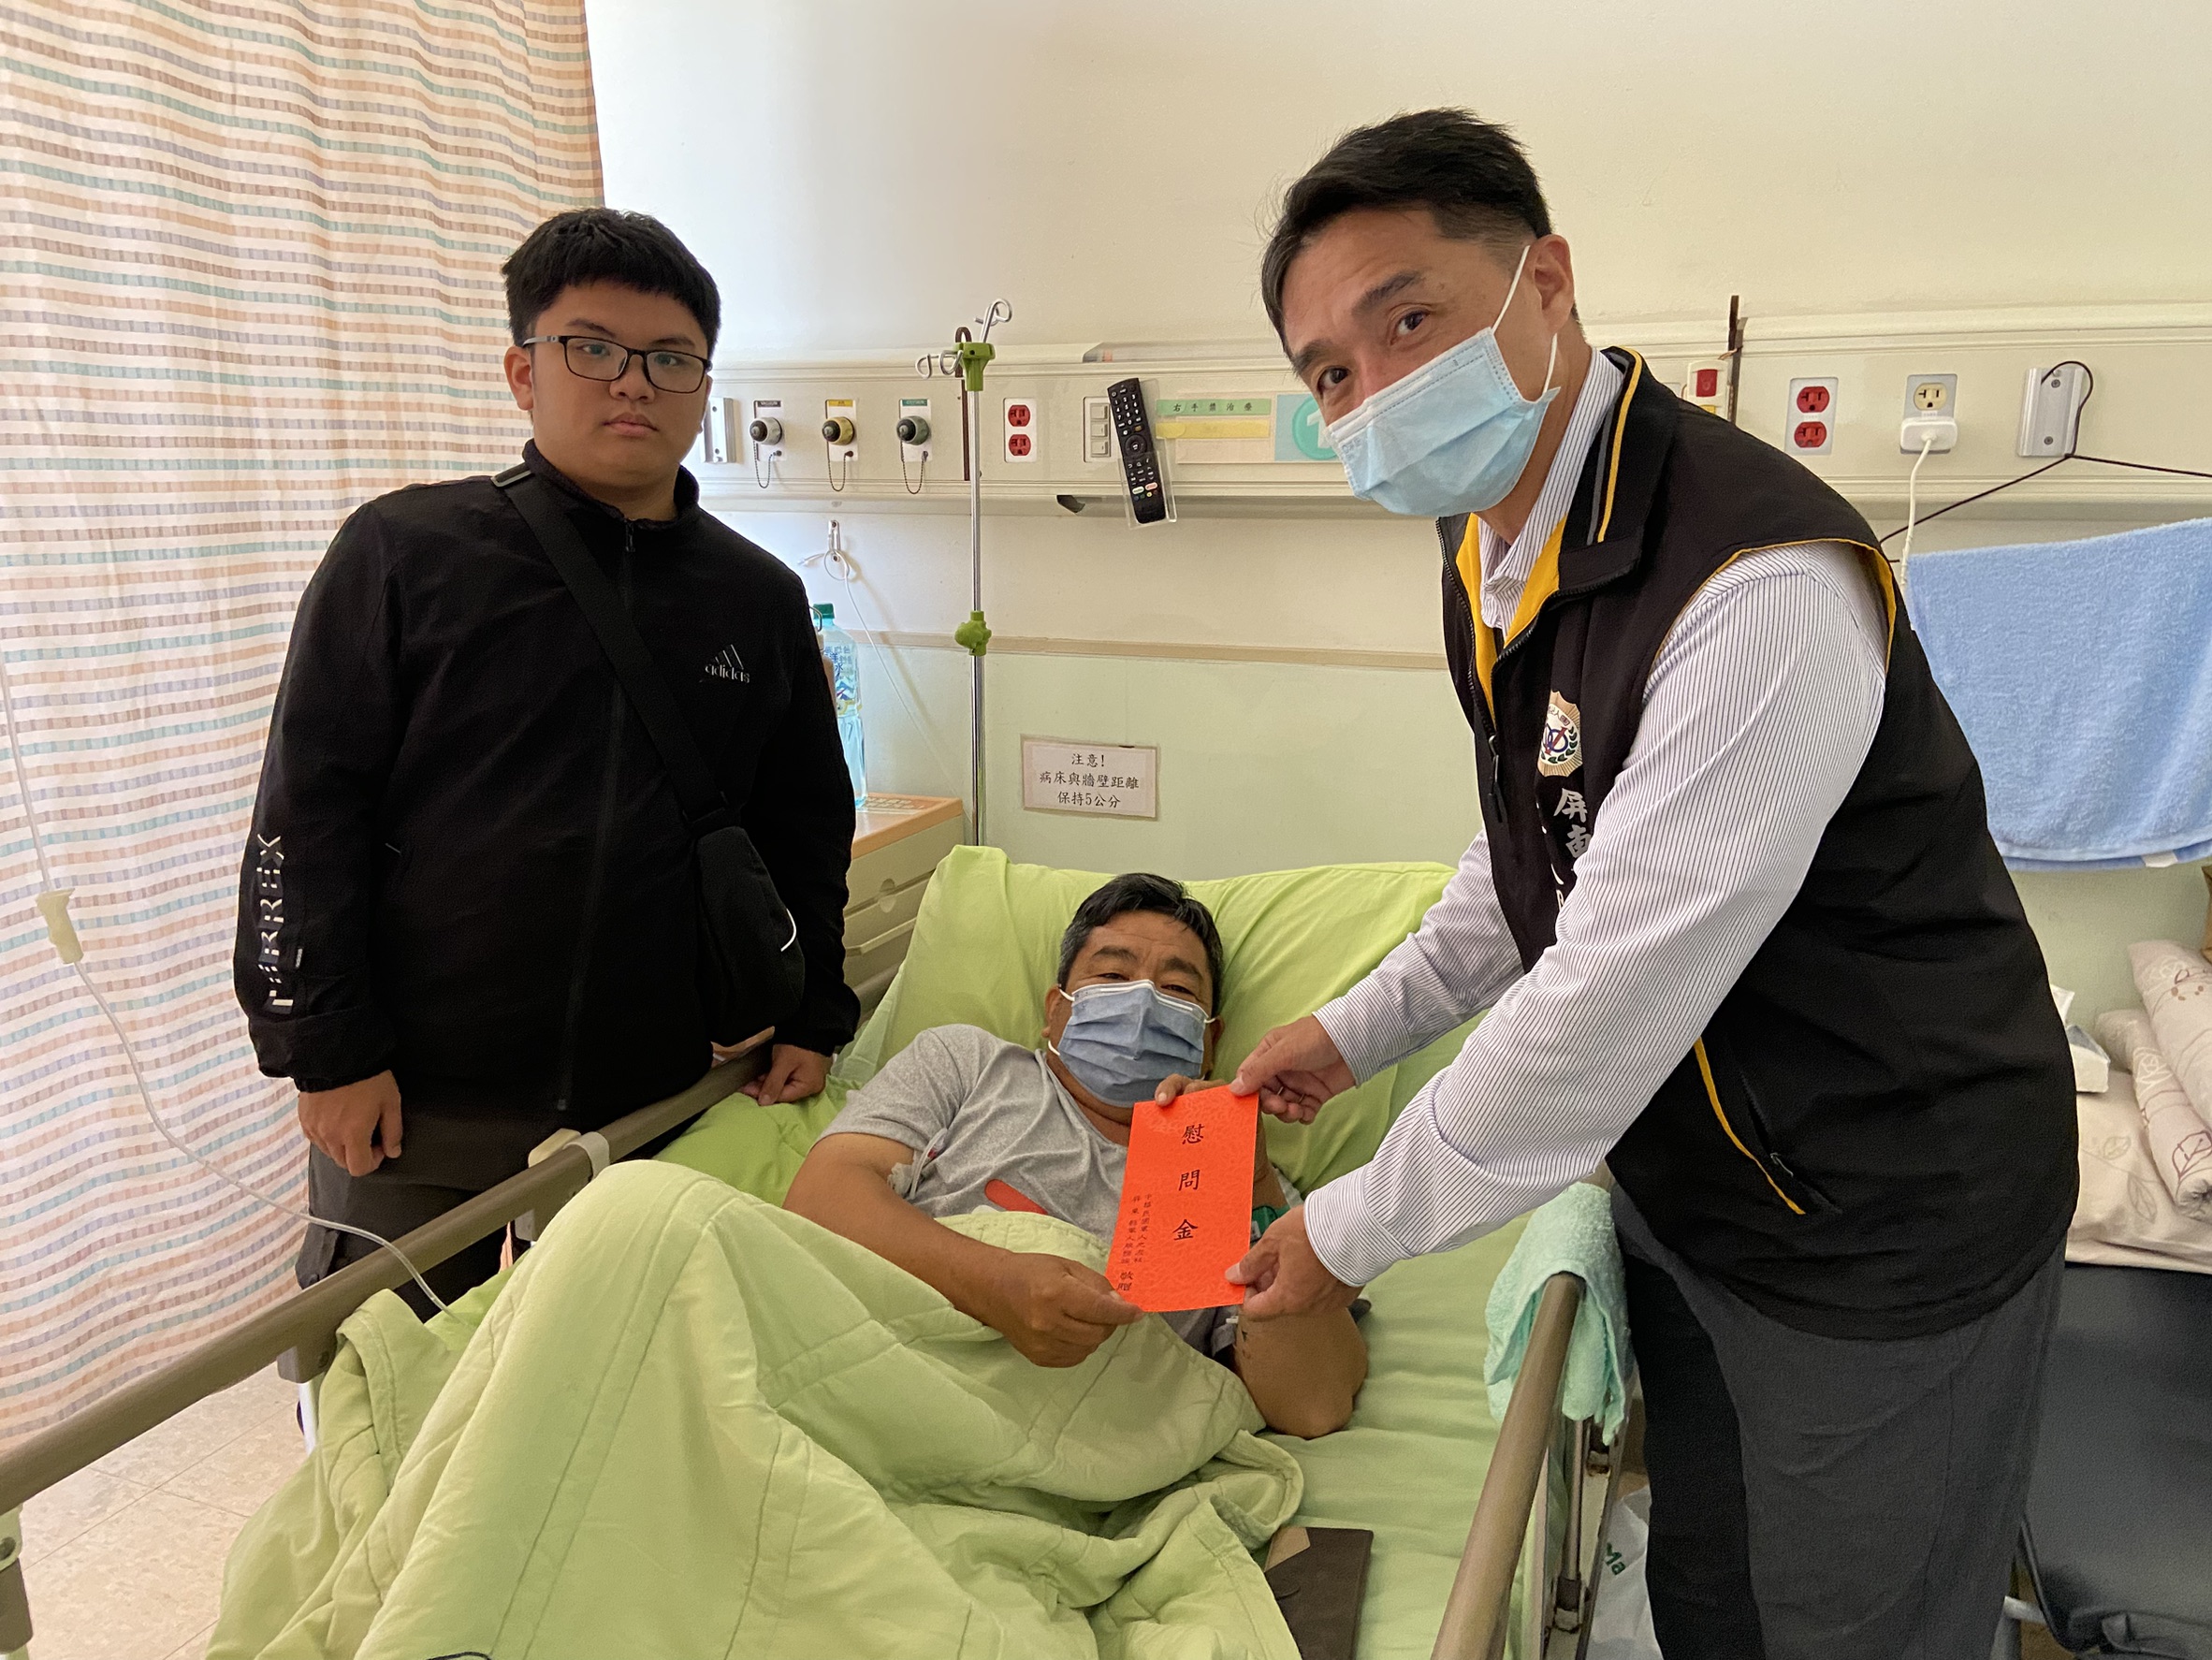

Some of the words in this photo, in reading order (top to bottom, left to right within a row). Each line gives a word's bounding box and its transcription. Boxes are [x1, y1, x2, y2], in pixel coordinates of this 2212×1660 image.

[705, 664, 749, 683] adidas
[1057, 791, 1121, 808] 保持5公分
[256, 833, 294, 1015] TERREX
[1172, 1123, 1204, 1241] 慰問金
